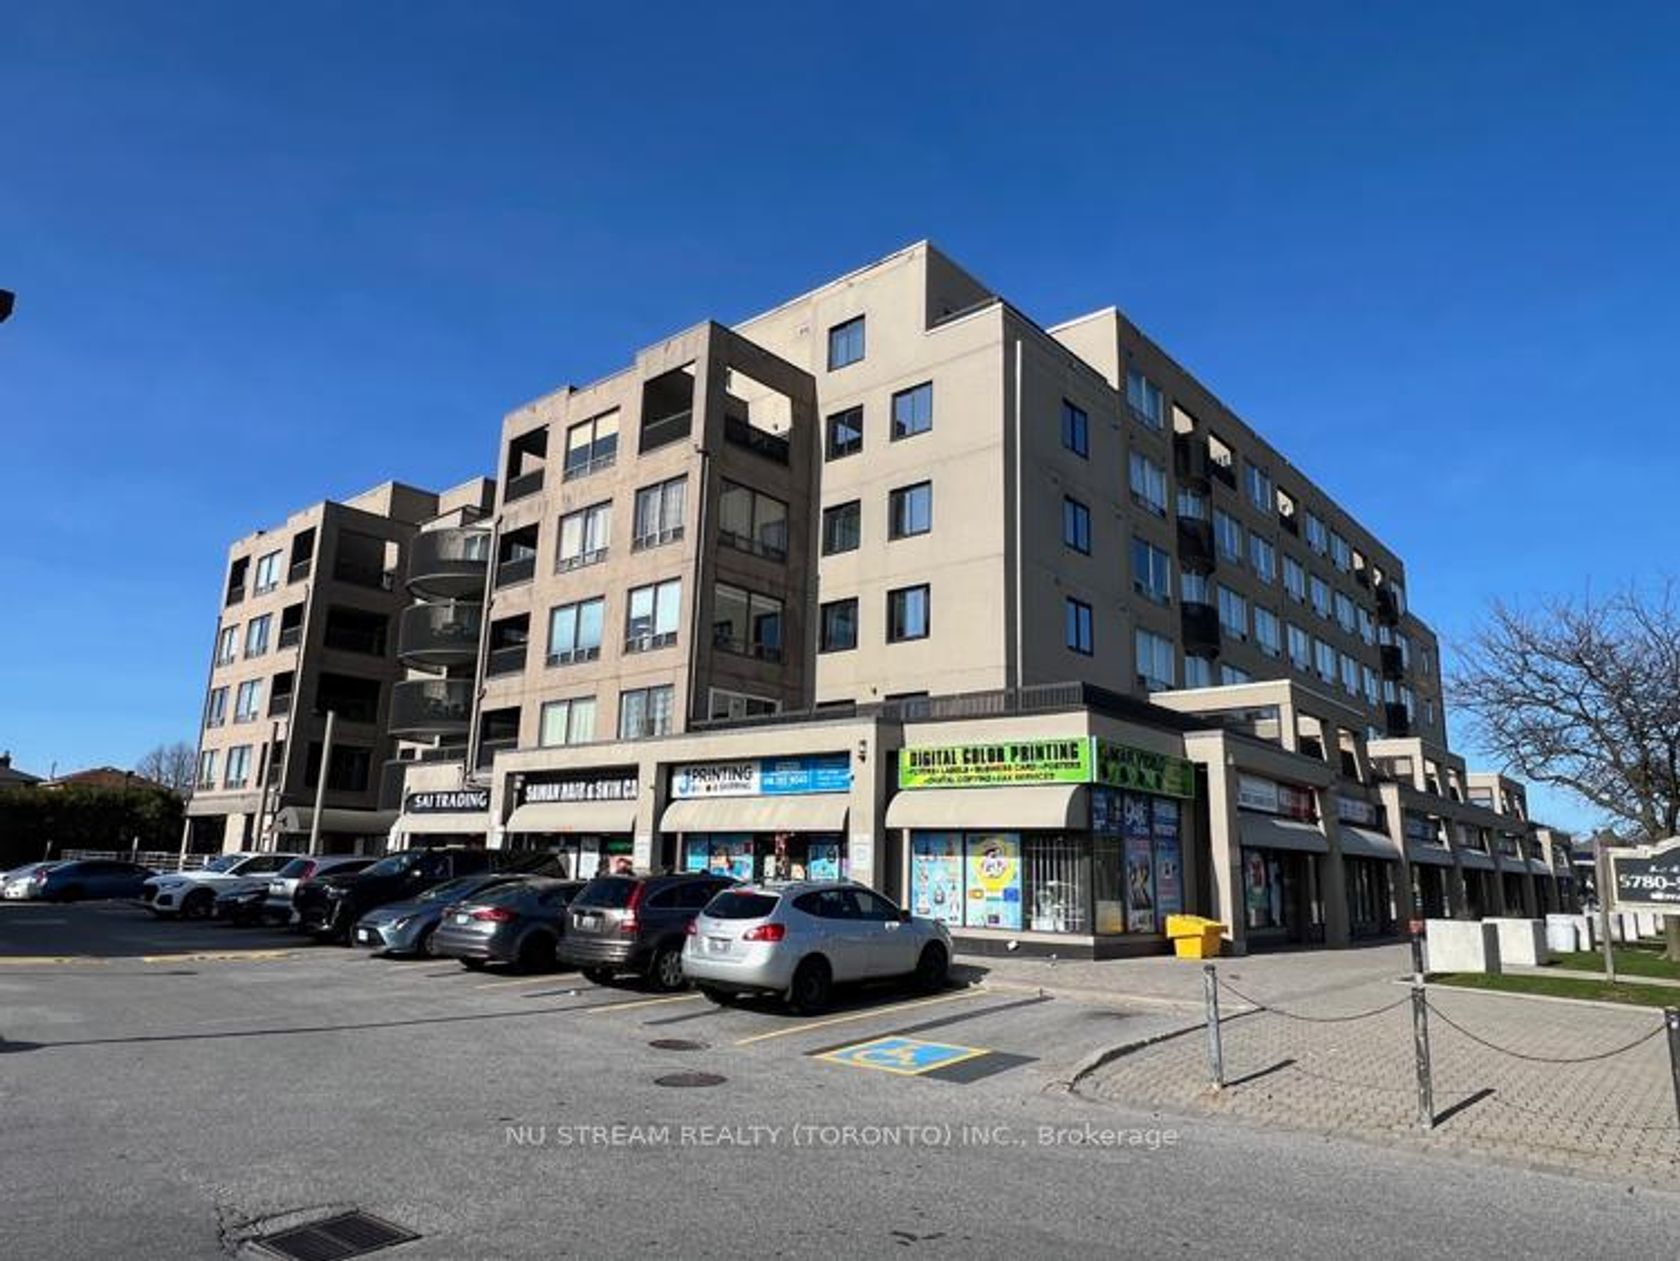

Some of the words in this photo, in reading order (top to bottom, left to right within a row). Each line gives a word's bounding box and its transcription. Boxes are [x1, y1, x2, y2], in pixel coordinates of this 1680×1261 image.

[910, 750, 956, 767] DIGITAL
[963, 748, 1004, 765] COLOR
[1010, 743, 1079, 761] PRINTING
[692, 764, 752, 782] PRINTING
[415, 794, 433, 808] SAI
[435, 791, 488, 808] TRADING
